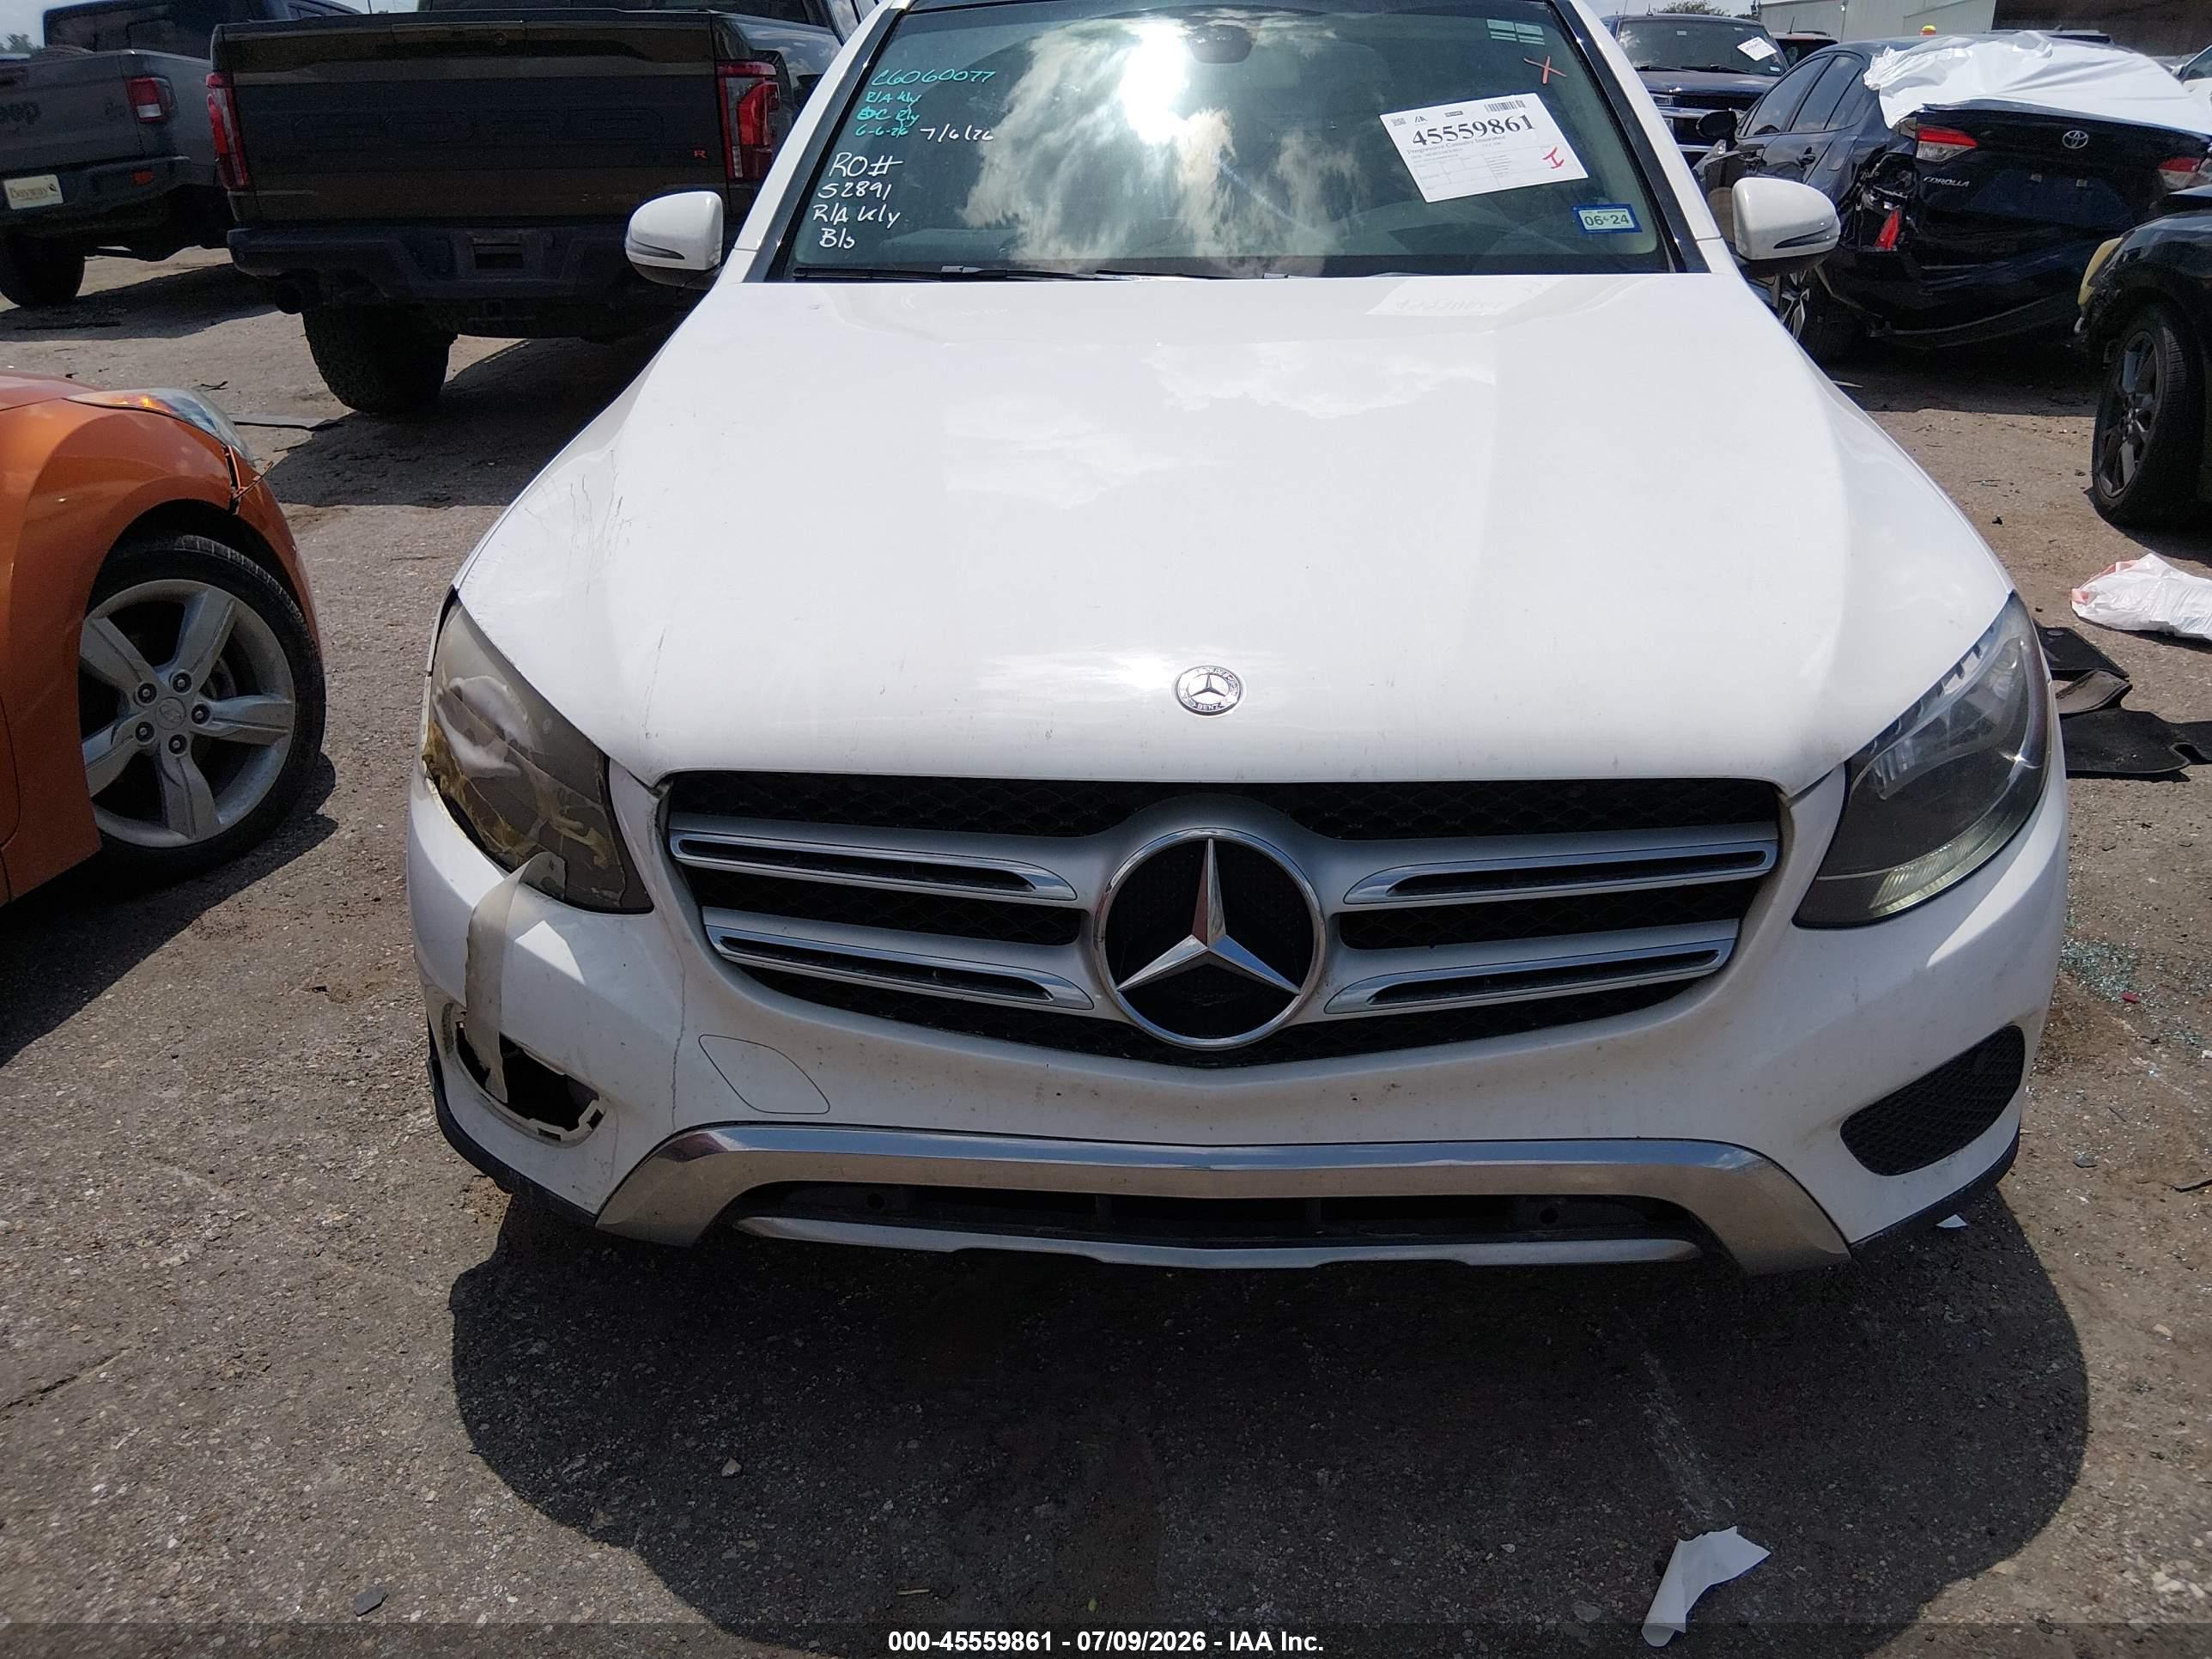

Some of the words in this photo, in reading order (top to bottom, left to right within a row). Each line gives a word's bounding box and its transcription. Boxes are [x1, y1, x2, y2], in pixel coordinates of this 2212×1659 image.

[1413, 114, 1535, 146] 45559861
[829, 152, 904, 177] RO#
[1923, 176, 1971, 187] COROLLA
